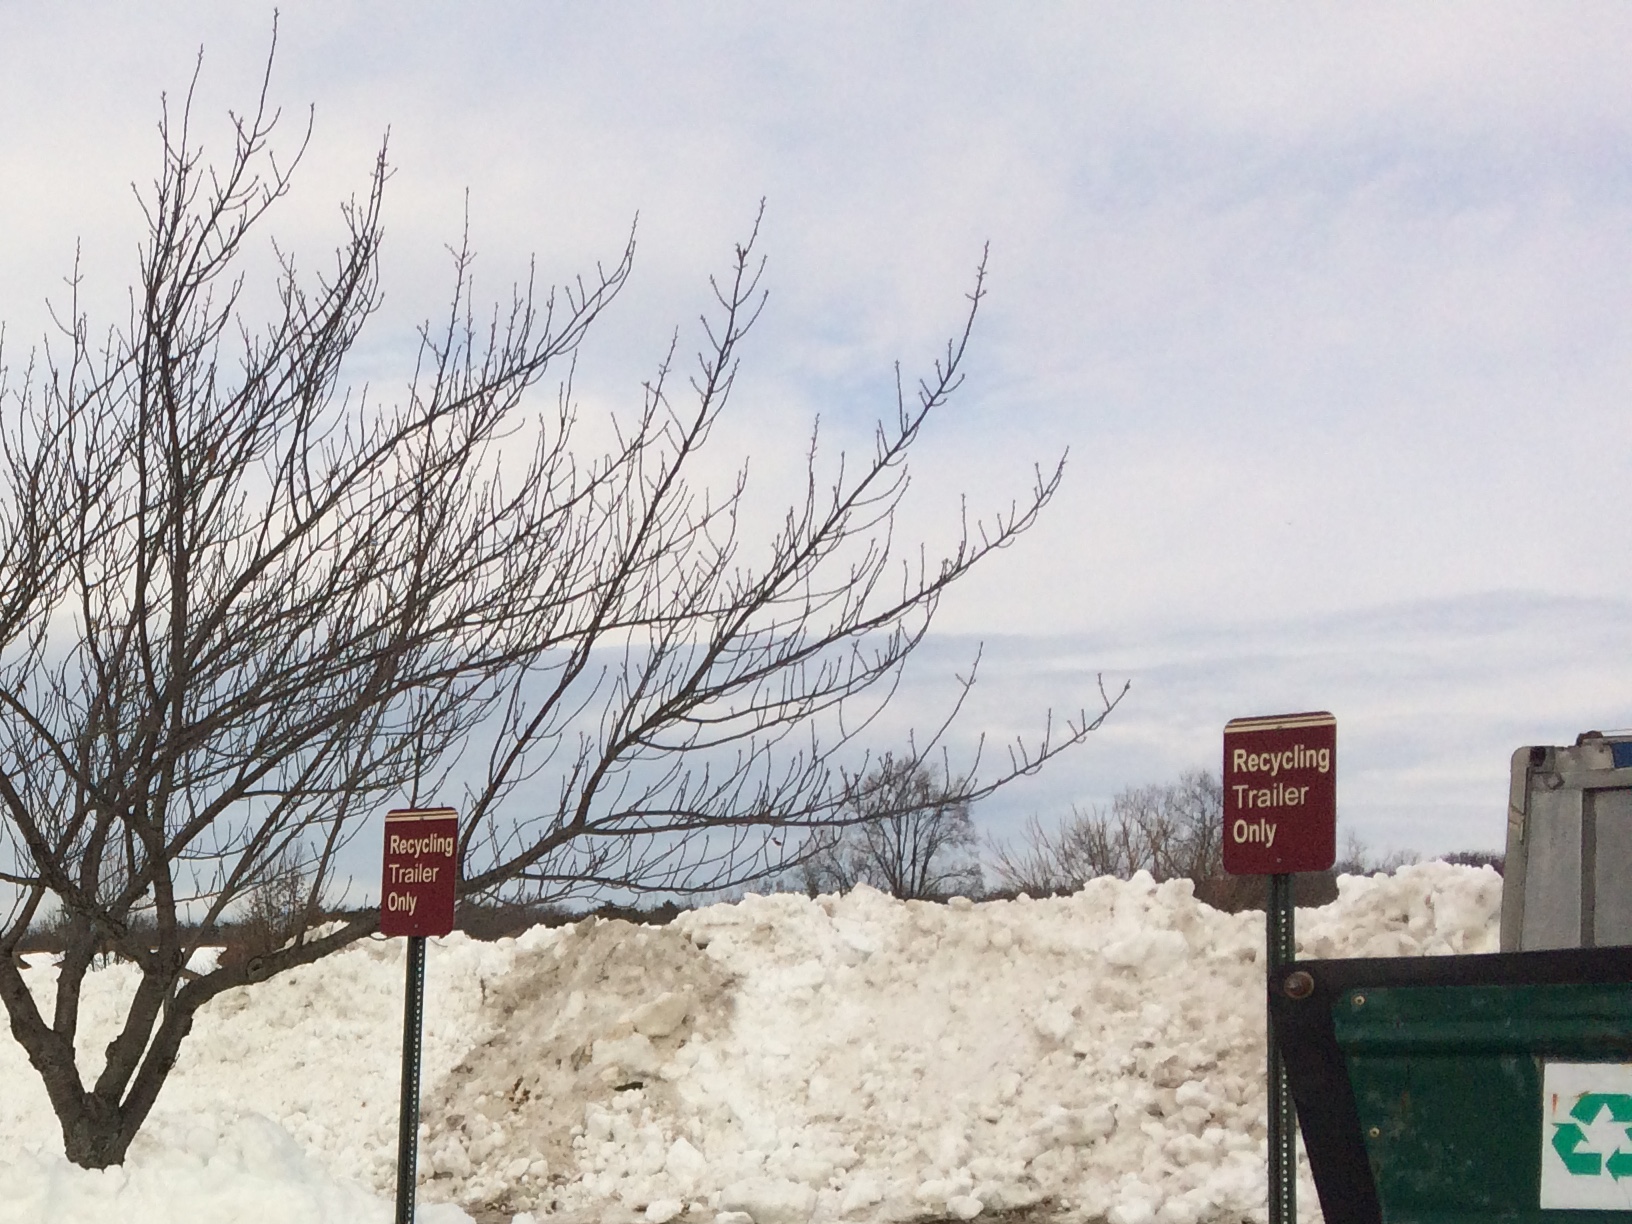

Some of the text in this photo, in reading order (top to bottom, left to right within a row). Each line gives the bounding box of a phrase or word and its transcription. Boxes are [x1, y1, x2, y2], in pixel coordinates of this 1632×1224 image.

[1233, 744, 1330, 776] Recycling
[1232, 783, 1309, 809] Trailer
[390, 833, 454, 858] Recycling
[1233, 818, 1277, 848] Only
[388, 863, 440, 884] Trailer
[388, 891, 417, 916] Only
